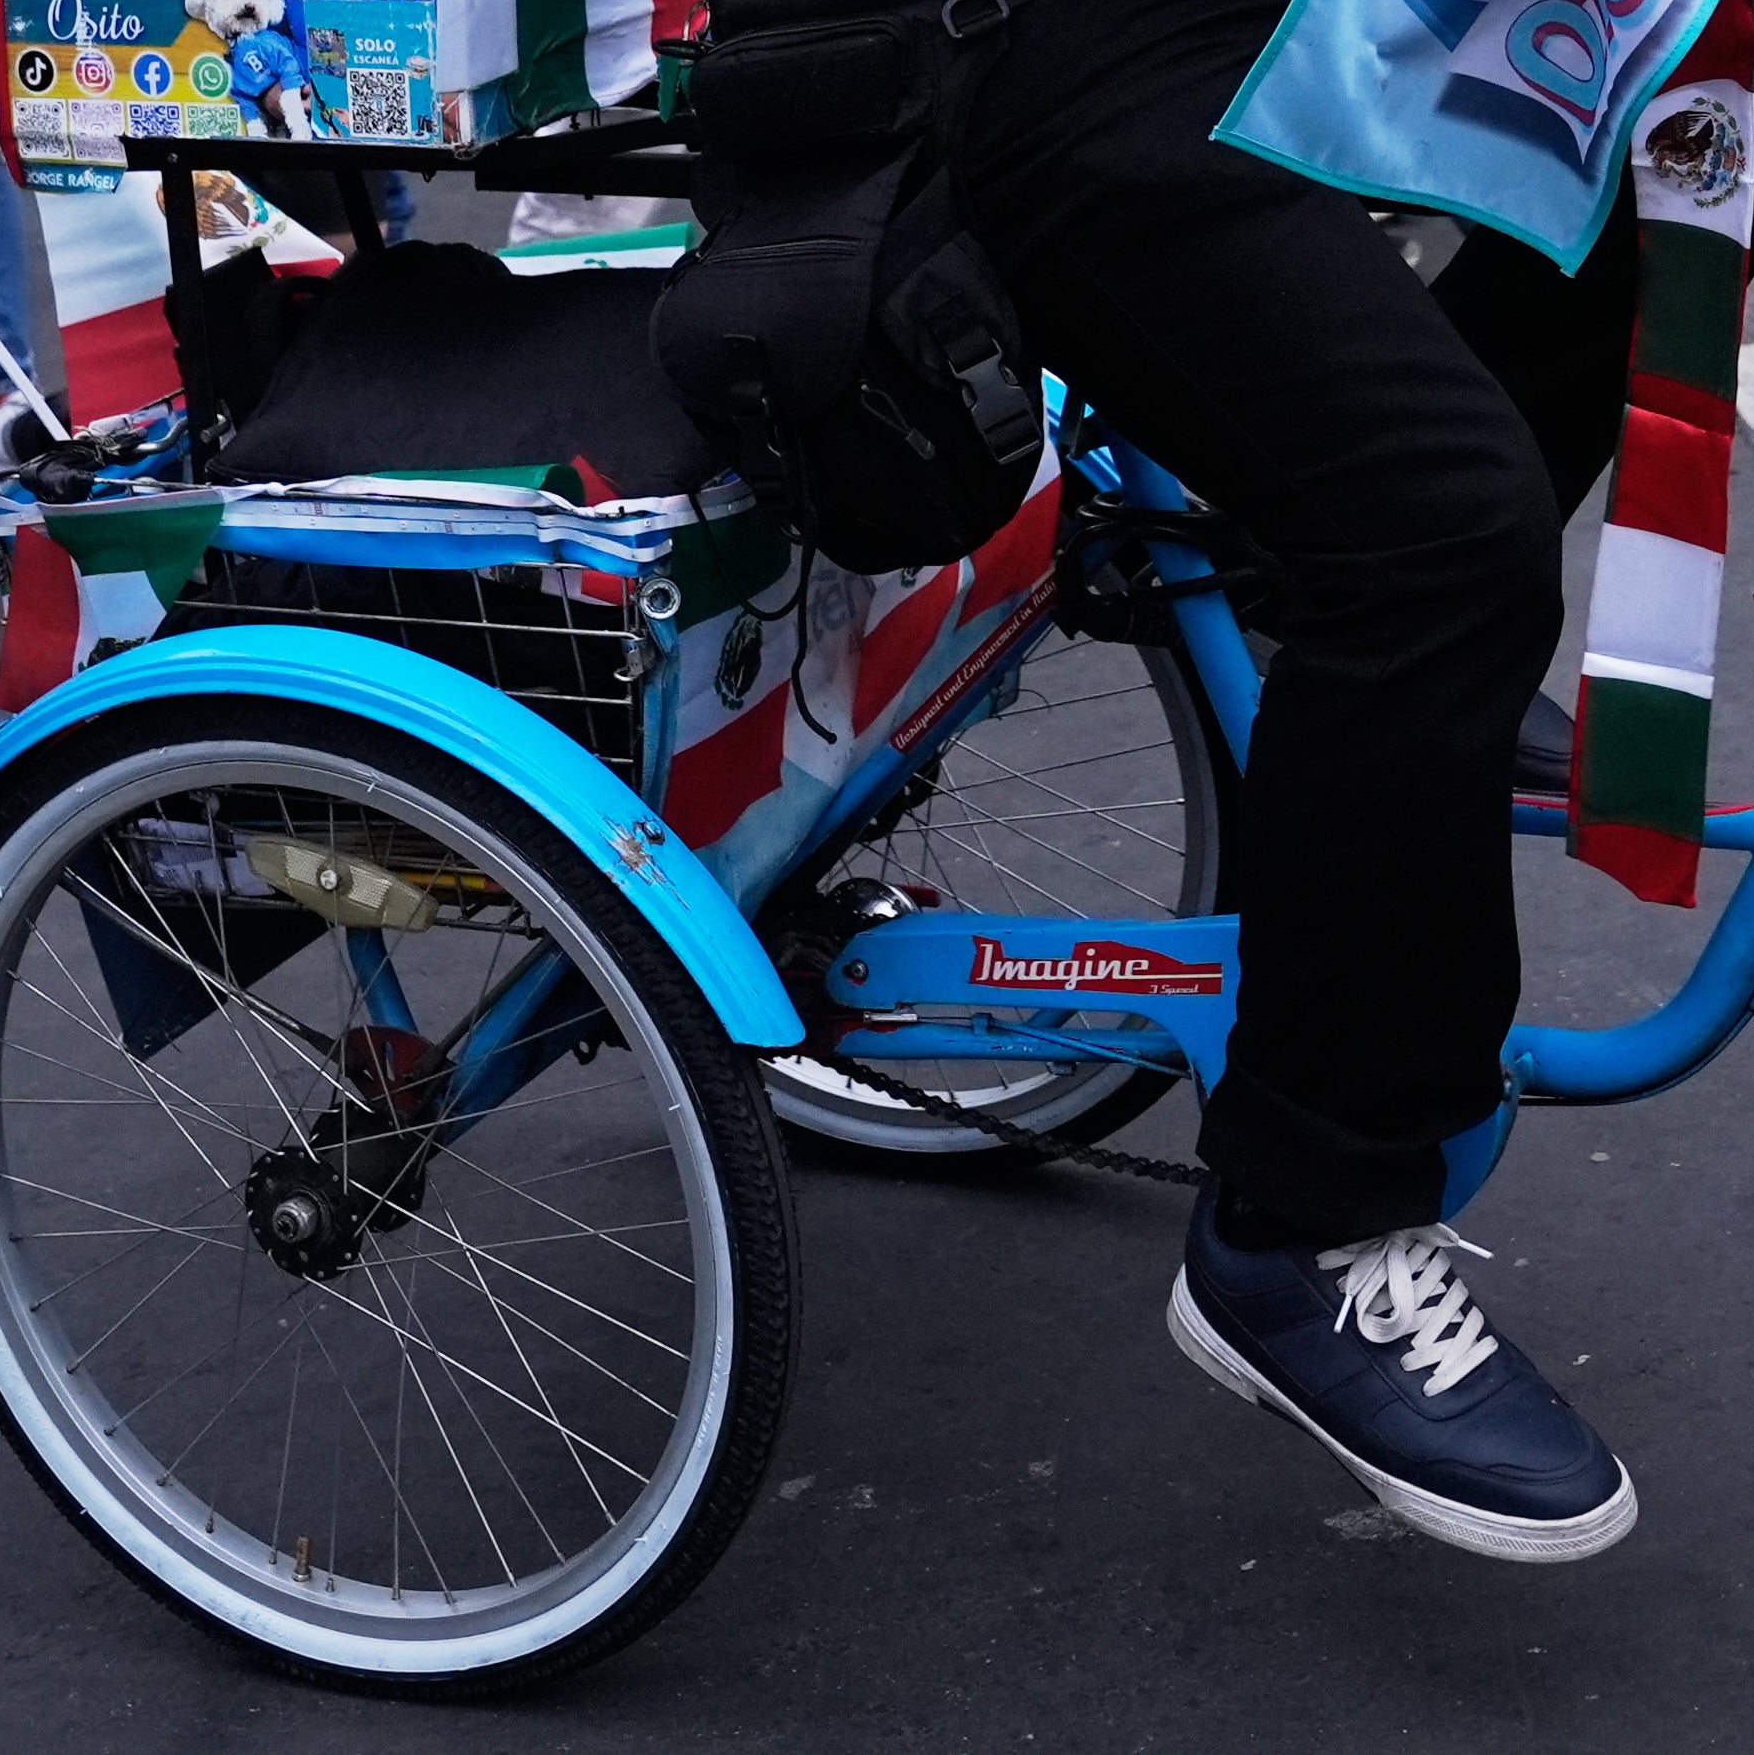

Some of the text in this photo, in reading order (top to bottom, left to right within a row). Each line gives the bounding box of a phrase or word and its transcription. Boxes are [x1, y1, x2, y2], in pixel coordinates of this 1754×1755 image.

[355, 38, 396, 53] SOLO
[67, 170, 117, 190] RANGEL
[945, 675, 967, 704] and
[976, 942, 1150, 992] Imagine
